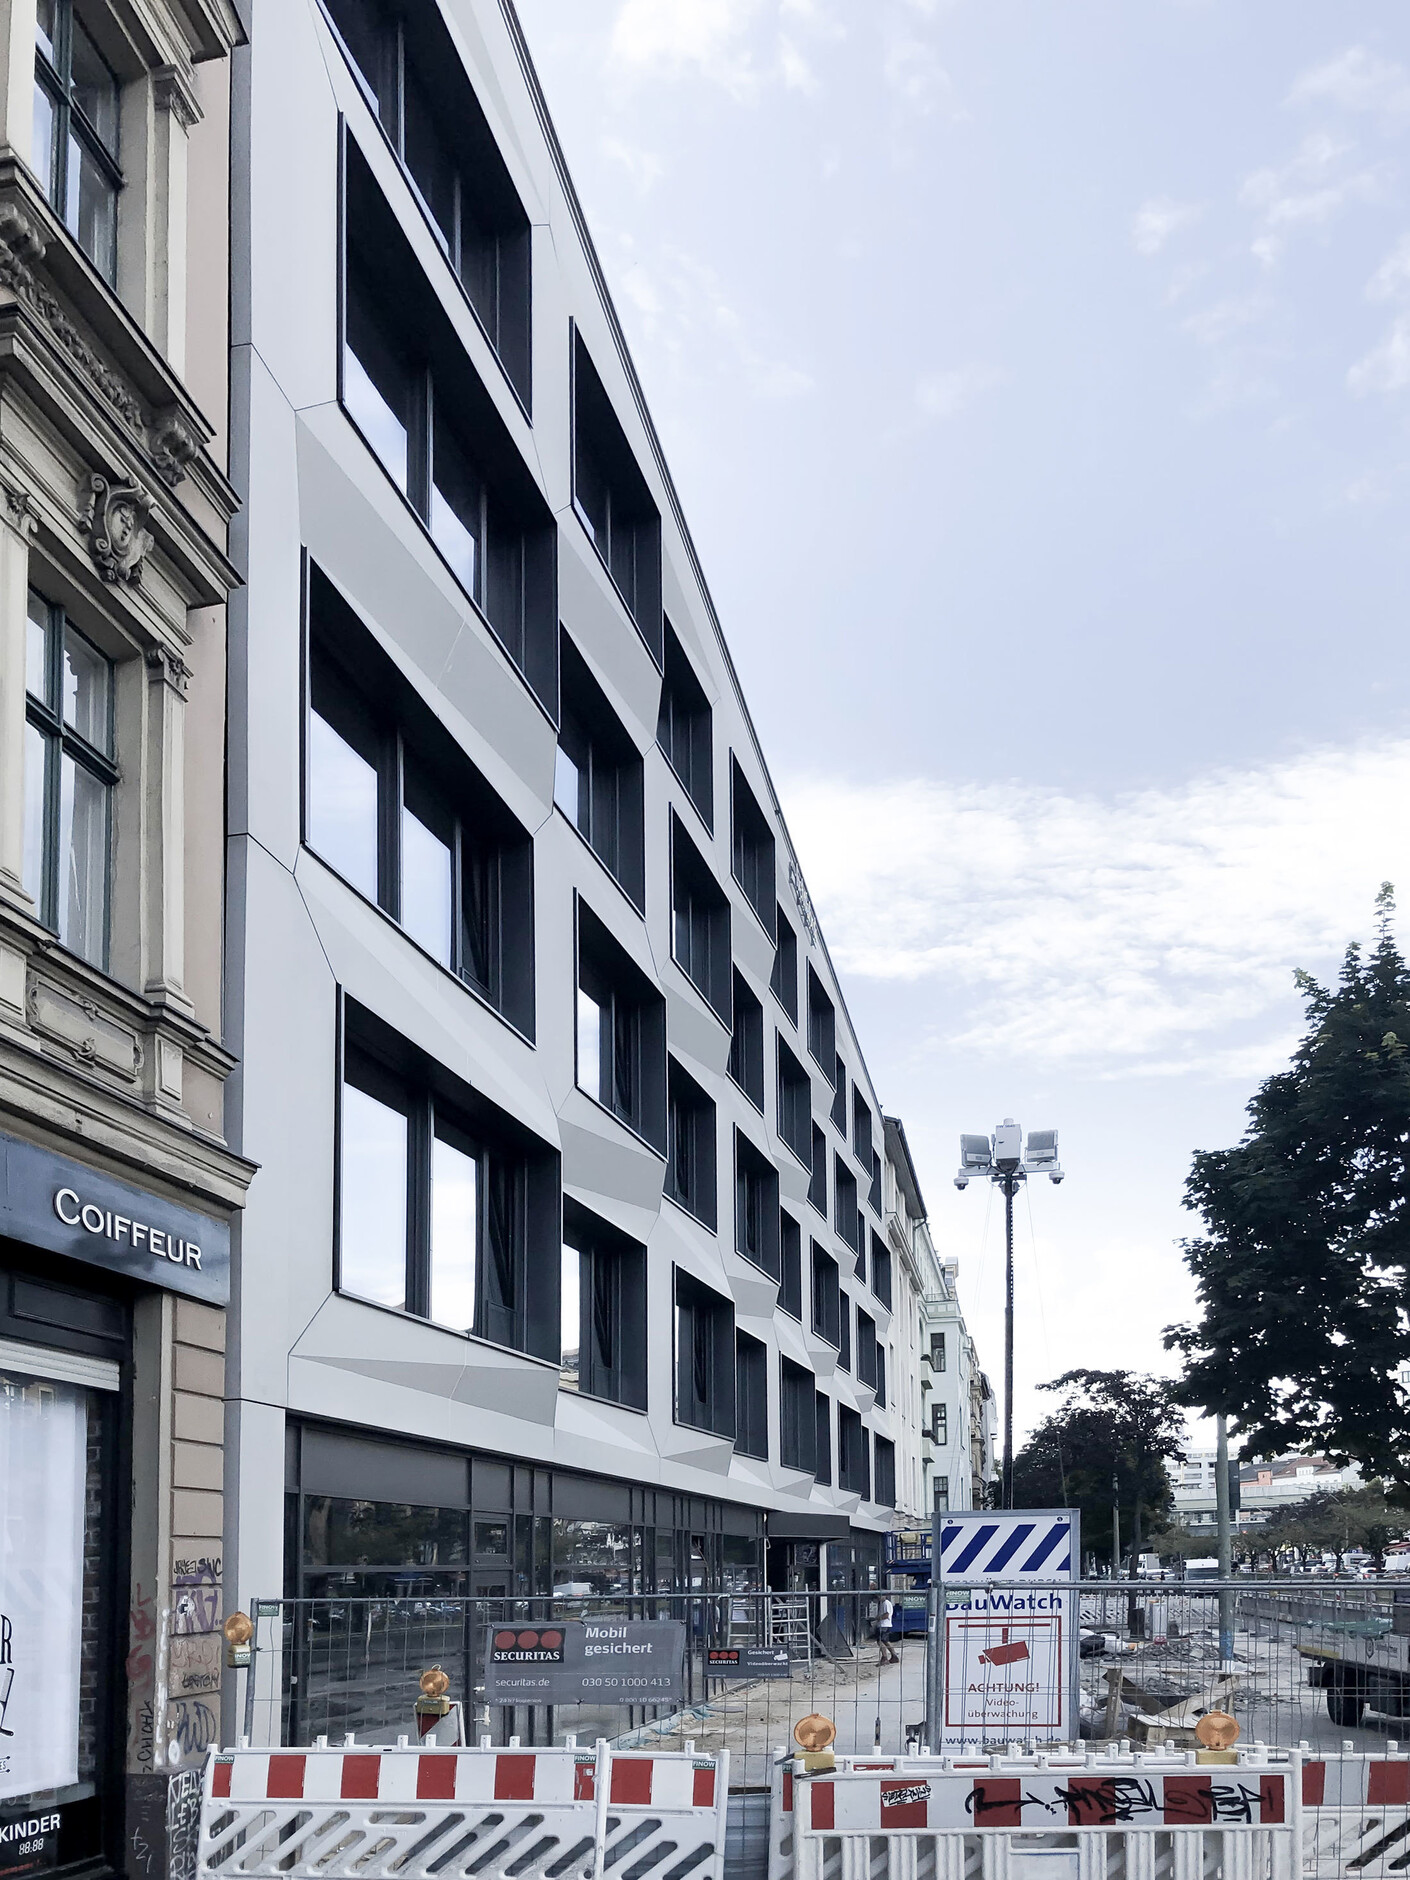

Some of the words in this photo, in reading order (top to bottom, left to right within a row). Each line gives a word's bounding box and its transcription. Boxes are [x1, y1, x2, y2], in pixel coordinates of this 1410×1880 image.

[55, 1188, 202, 1270] COIFFEUR
[585, 1626, 627, 1638] Mobil
[584, 1642, 653, 1656] gesichert
[493, 1651, 560, 1661] SECURITAS
[495, 1677, 550, 1687] securitas.de
[581, 1677, 602, 1687] 030
[604, 1677, 618, 1687] 50
[621, 1677, 648, 1687] 1000
[650, 1677, 671, 1687] 413
[968, 1682, 1039, 1692] ACHTUNG!
[986, 1698, 1019, 1706] Video-
[968, 1709, 1038, 1720] überwachung
[945, 1736, 1061, 1744] www.bauwathde
[0, 1813, 61, 1843] KINDER
